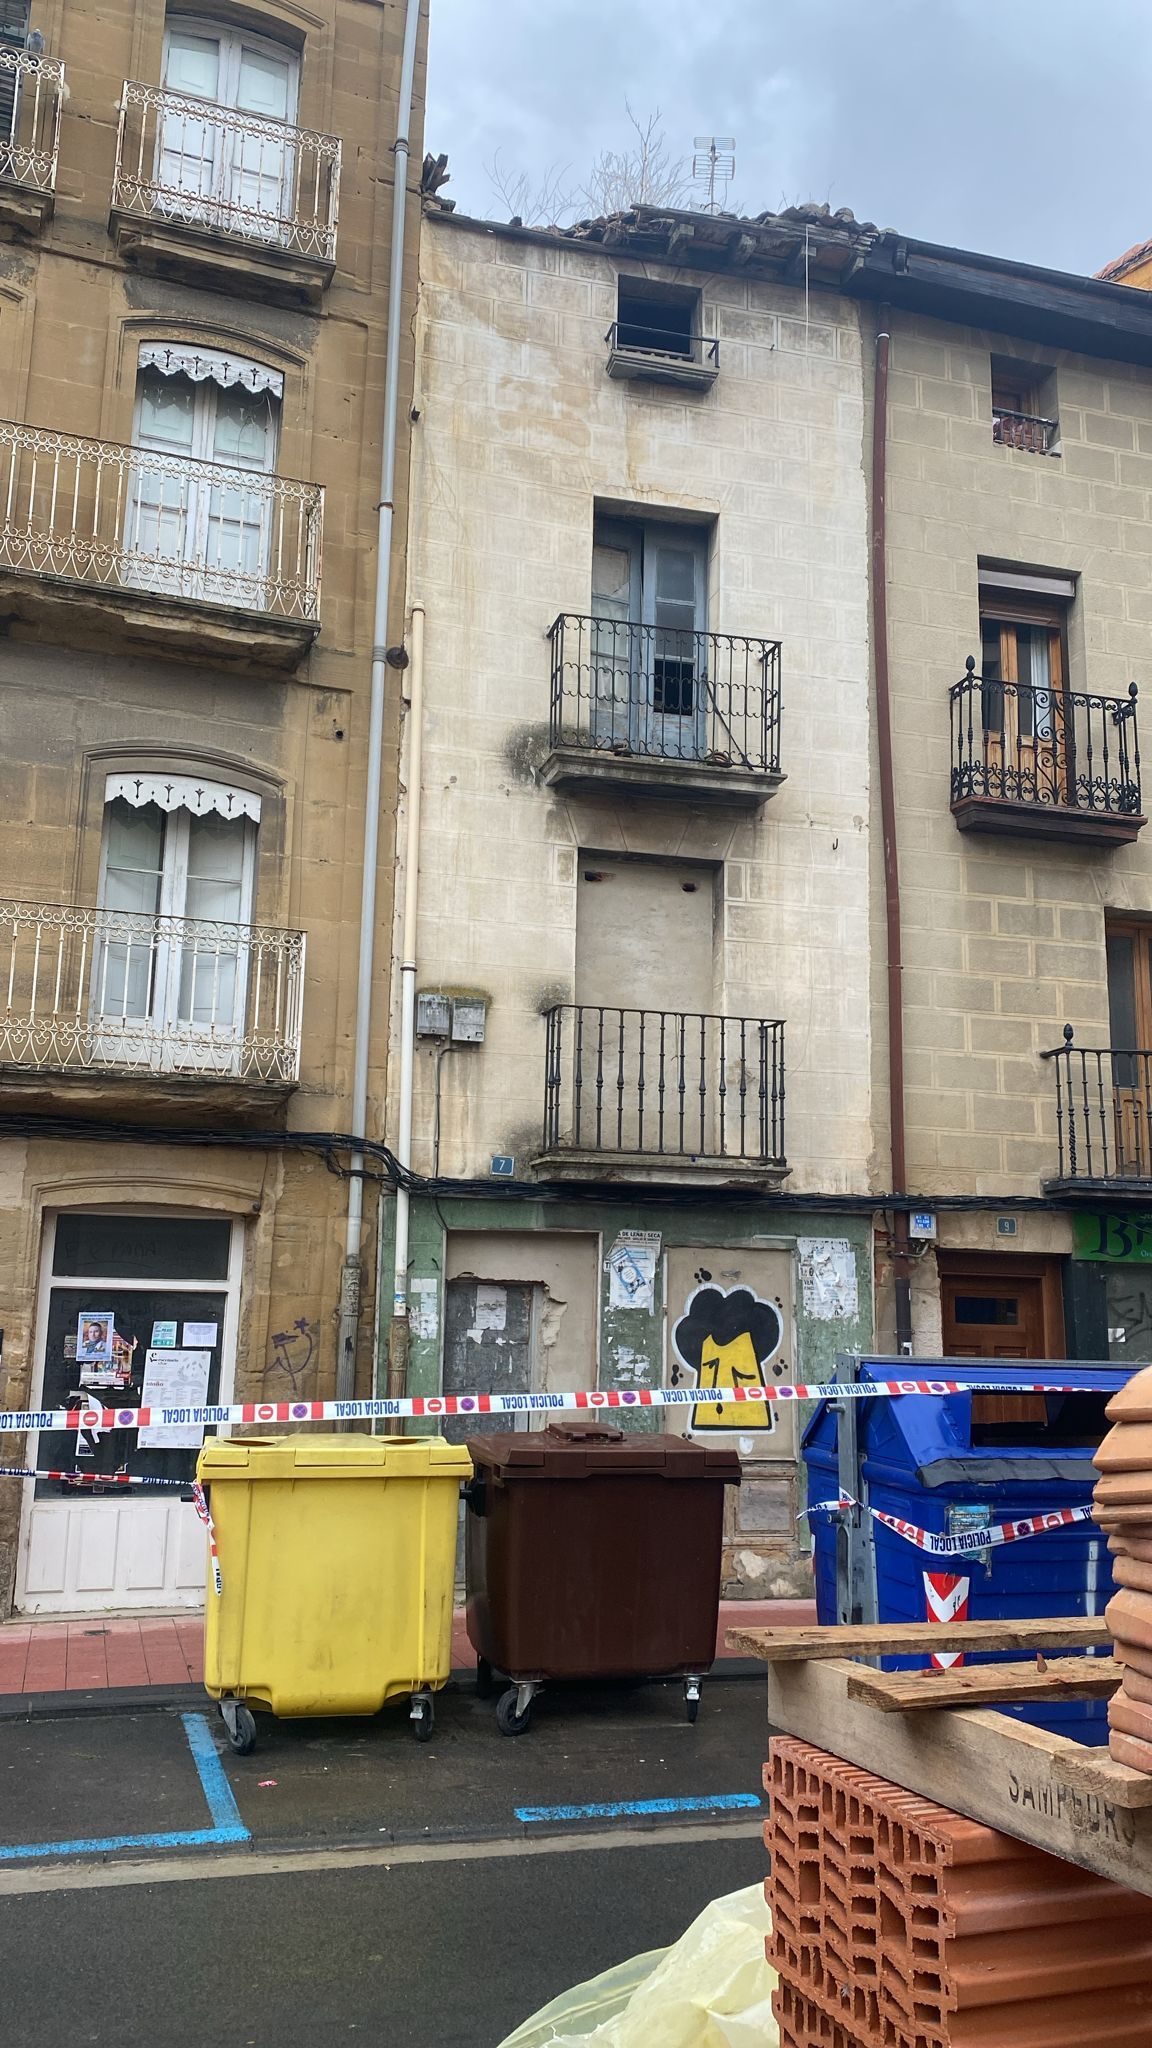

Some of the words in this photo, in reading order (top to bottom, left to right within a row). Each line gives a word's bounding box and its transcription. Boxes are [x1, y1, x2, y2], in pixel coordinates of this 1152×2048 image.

[690, 1388, 723, 1401] POLICIA
[817, 1385, 843, 1397] LOCAL
[844, 1382, 878, 1394] POLICIA
[500, 1396, 528, 1410] LOCAL
[529, 1394, 564, 1408] POLICIA
[661, 1391, 689, 1403] LOCAL
[193, 1407, 229, 1422] POLICIA
[334, 1403, 363, 1417] LOCAL
[364, 1401, 399, 1415] POLICIA
[15, 1412, 53, 1428] POLICIA
[162, 1409, 191, 1424] LOCAL
[930, 1535, 958, 1551] LOCAL
[959, 1530, 992, 1550] POLICIA
